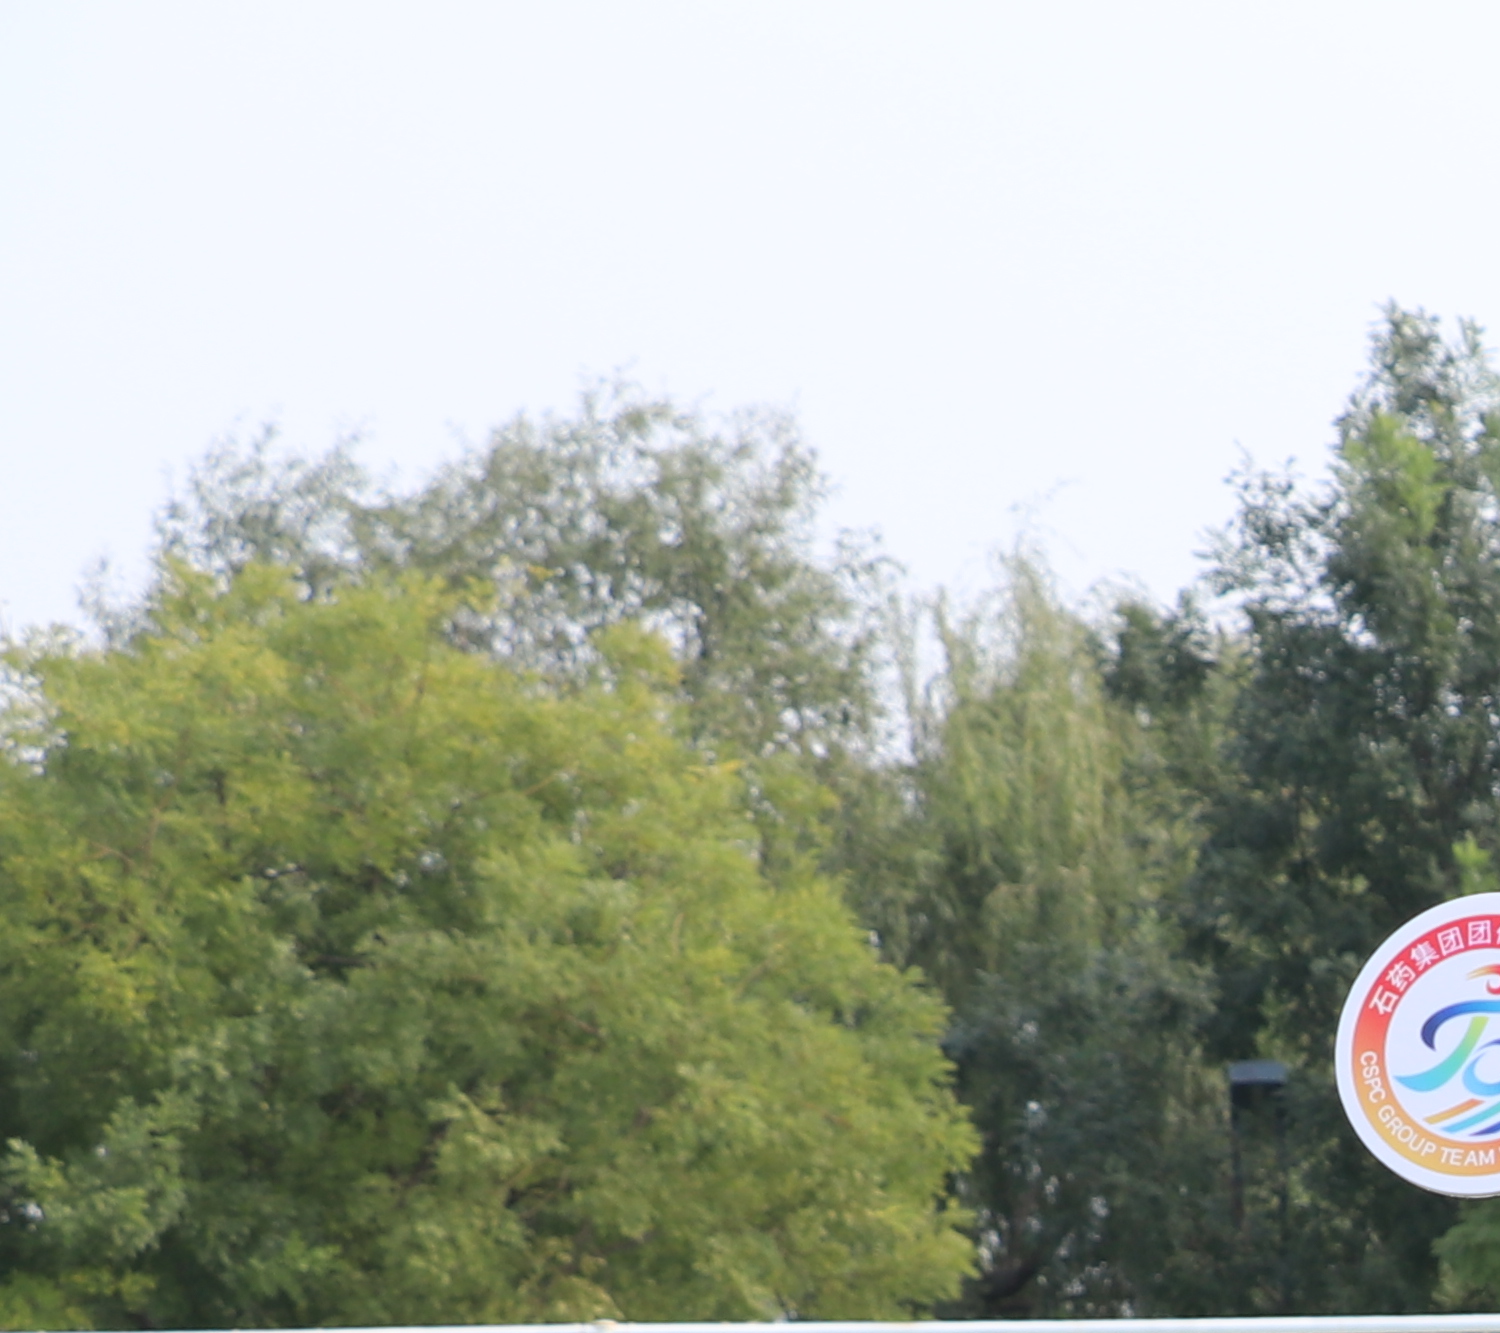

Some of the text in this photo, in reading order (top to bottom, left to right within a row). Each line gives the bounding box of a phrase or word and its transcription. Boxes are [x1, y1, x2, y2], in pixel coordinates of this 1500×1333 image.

[1360, 1051, 1386, 1102] CSPC
[1377, 1104, 1437, 1157] GROUP
[1440, 1146, 1496, 1167] TEAM
